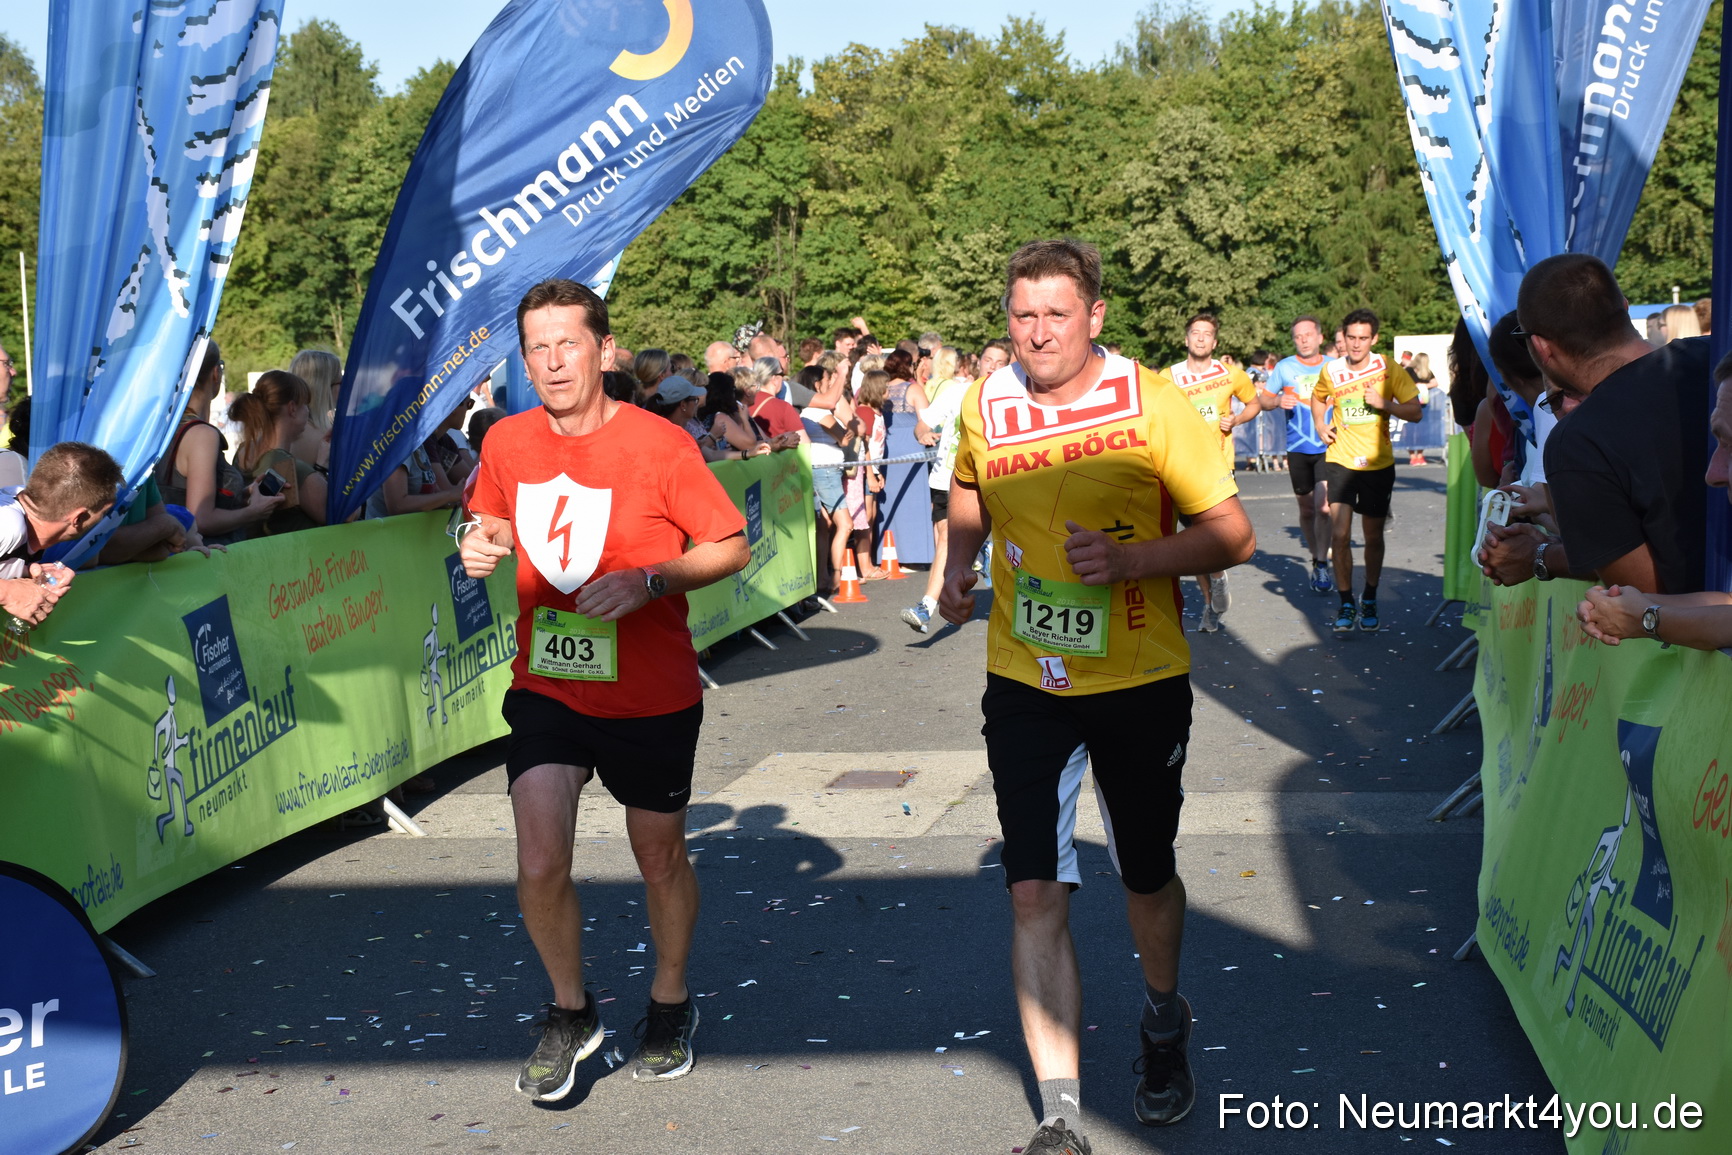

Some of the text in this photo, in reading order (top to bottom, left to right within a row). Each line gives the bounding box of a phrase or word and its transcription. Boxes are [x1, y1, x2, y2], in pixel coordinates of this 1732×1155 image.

[1612, 40, 1650, 120] Druck
[561, 54, 745, 227] Druck und Medien
[390, 94, 648, 340] Frischmann
[342, 325, 491, 496] www.frischmann-net.de
[1204, 376, 1234, 393] BÖGL
[1335, 385, 1361, 399] MAX
[986, 427, 1148, 481] MAX BÖGL
[269, 549, 369, 620] Gesunde Firmen
[302, 574, 388, 655] laufen länger!
[1022, 599, 1095, 636] 1219
[1029, 625, 1051, 638] Beyer
[1051, 631, 1082, 643] Richard
[201, 635, 230, 665] Fischer
[446, 612, 518, 692] firmenla
[541, 657, 602, 670] Wittmann Gerhard
[544, 634, 595, 662] 403
[451, 677, 486, 715] neumarkt
[189, 664, 297, 795] firmenlauf
[199, 769, 249, 823] neumarkt
[1590, 880, 1706, 1048] firmenlauf
[1578, 994, 1622, 1051] neumarkt
